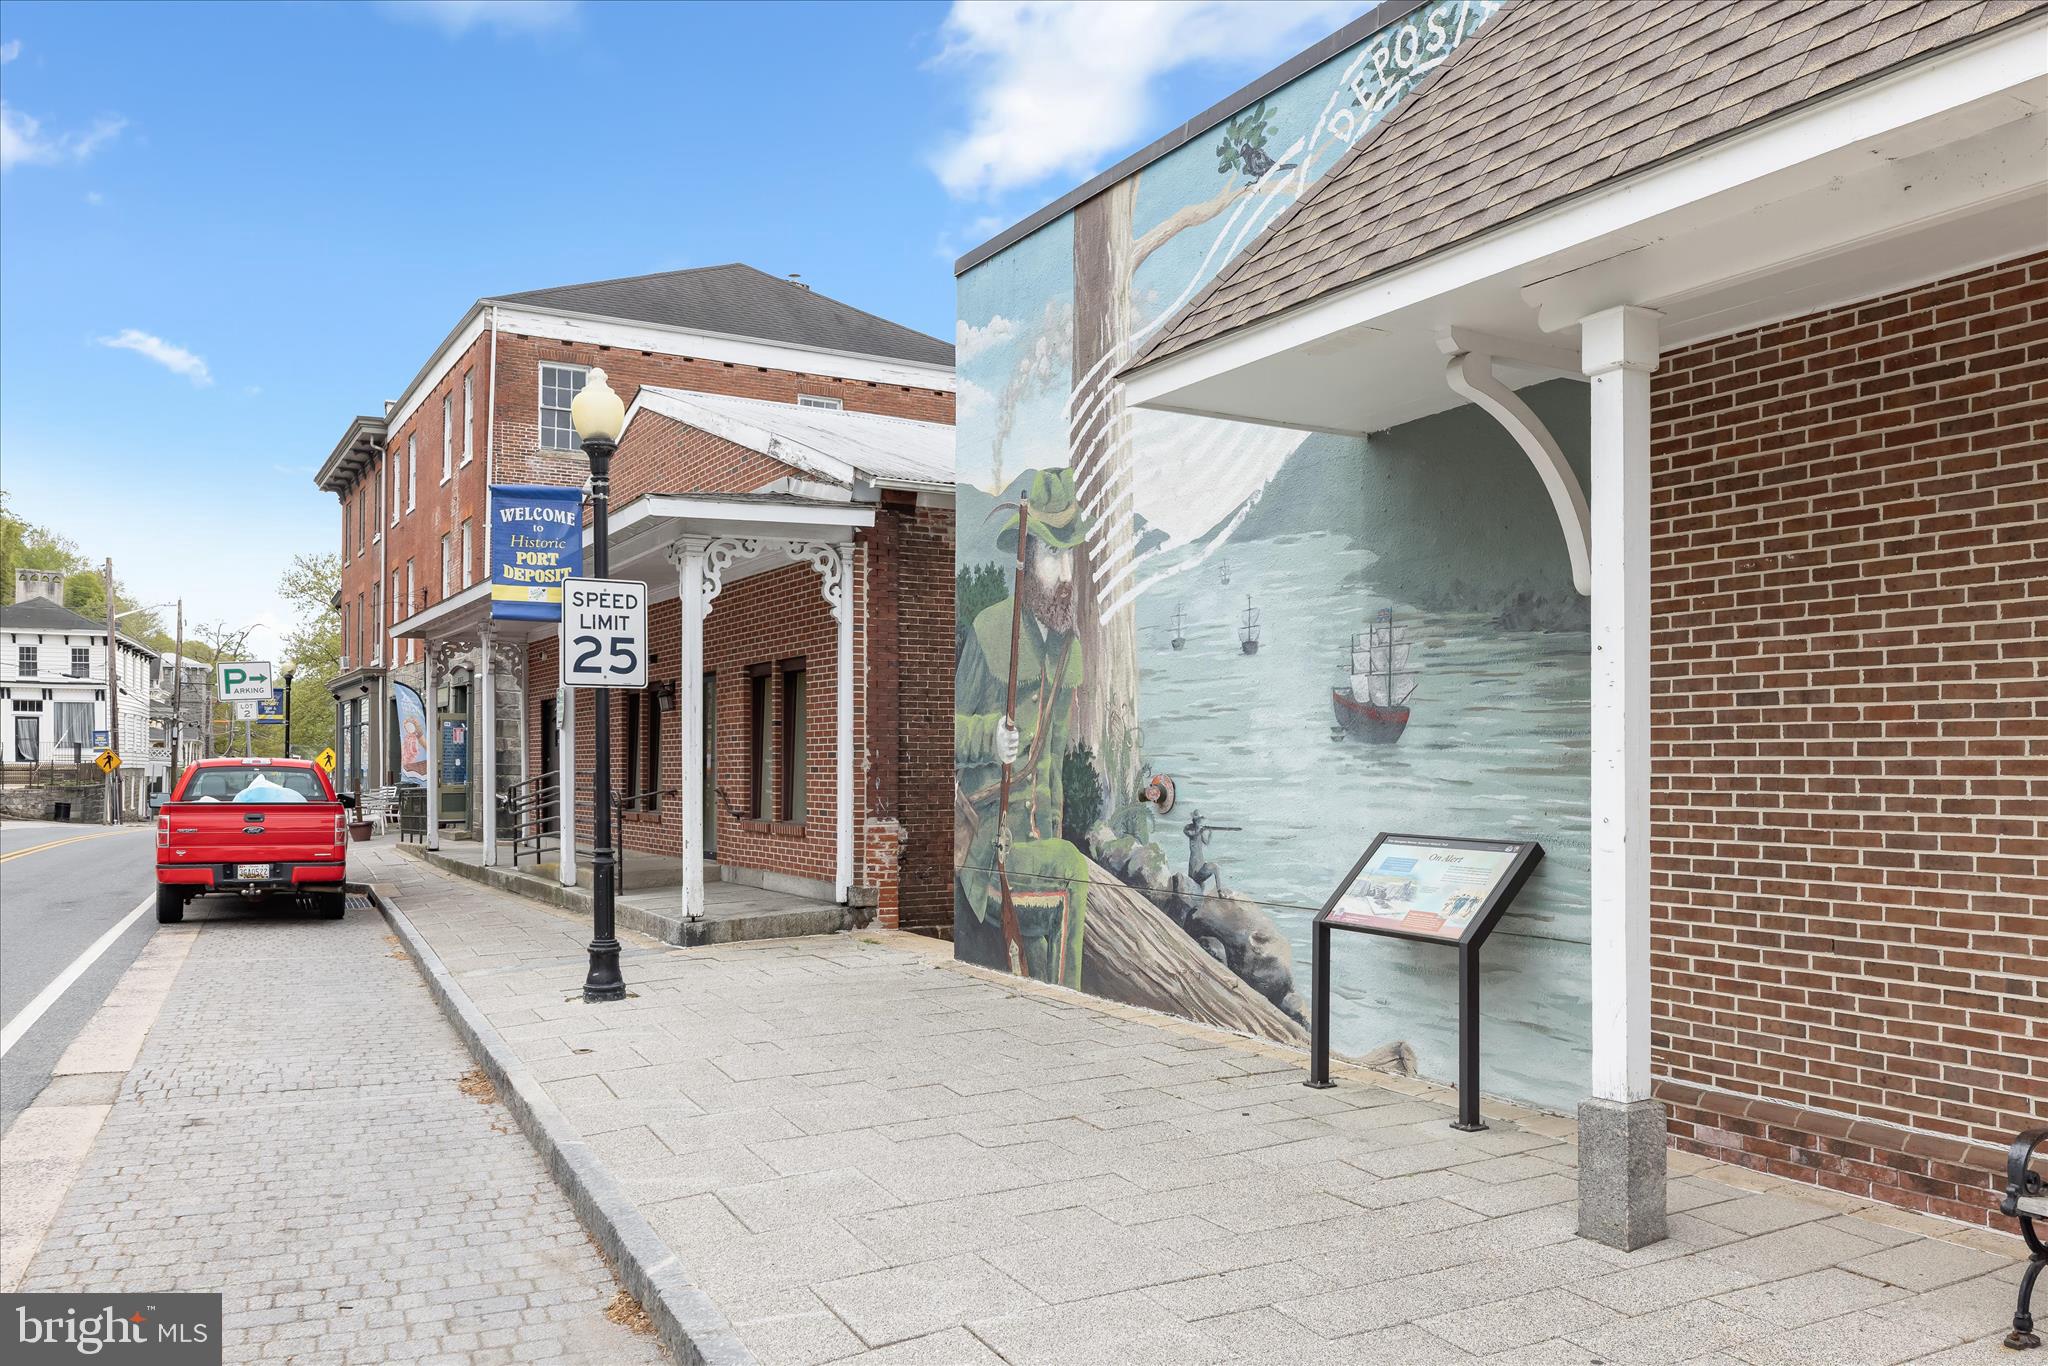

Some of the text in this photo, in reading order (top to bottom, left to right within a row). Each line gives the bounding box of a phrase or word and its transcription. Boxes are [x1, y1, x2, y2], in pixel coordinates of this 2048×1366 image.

[500, 506, 576, 527] WELCOME
[533, 524, 544, 532] to
[510, 534, 567, 549] Historic
[515, 551, 560, 566] PORT
[503, 563, 573, 583] DEPOSIT
[572, 591, 638, 610] SPEED
[580, 613, 630, 631] LIMIT
[572, 635, 638, 675] 25
[243, 710, 251, 718] 2
[1429, 853, 1464, 863] On Alert
